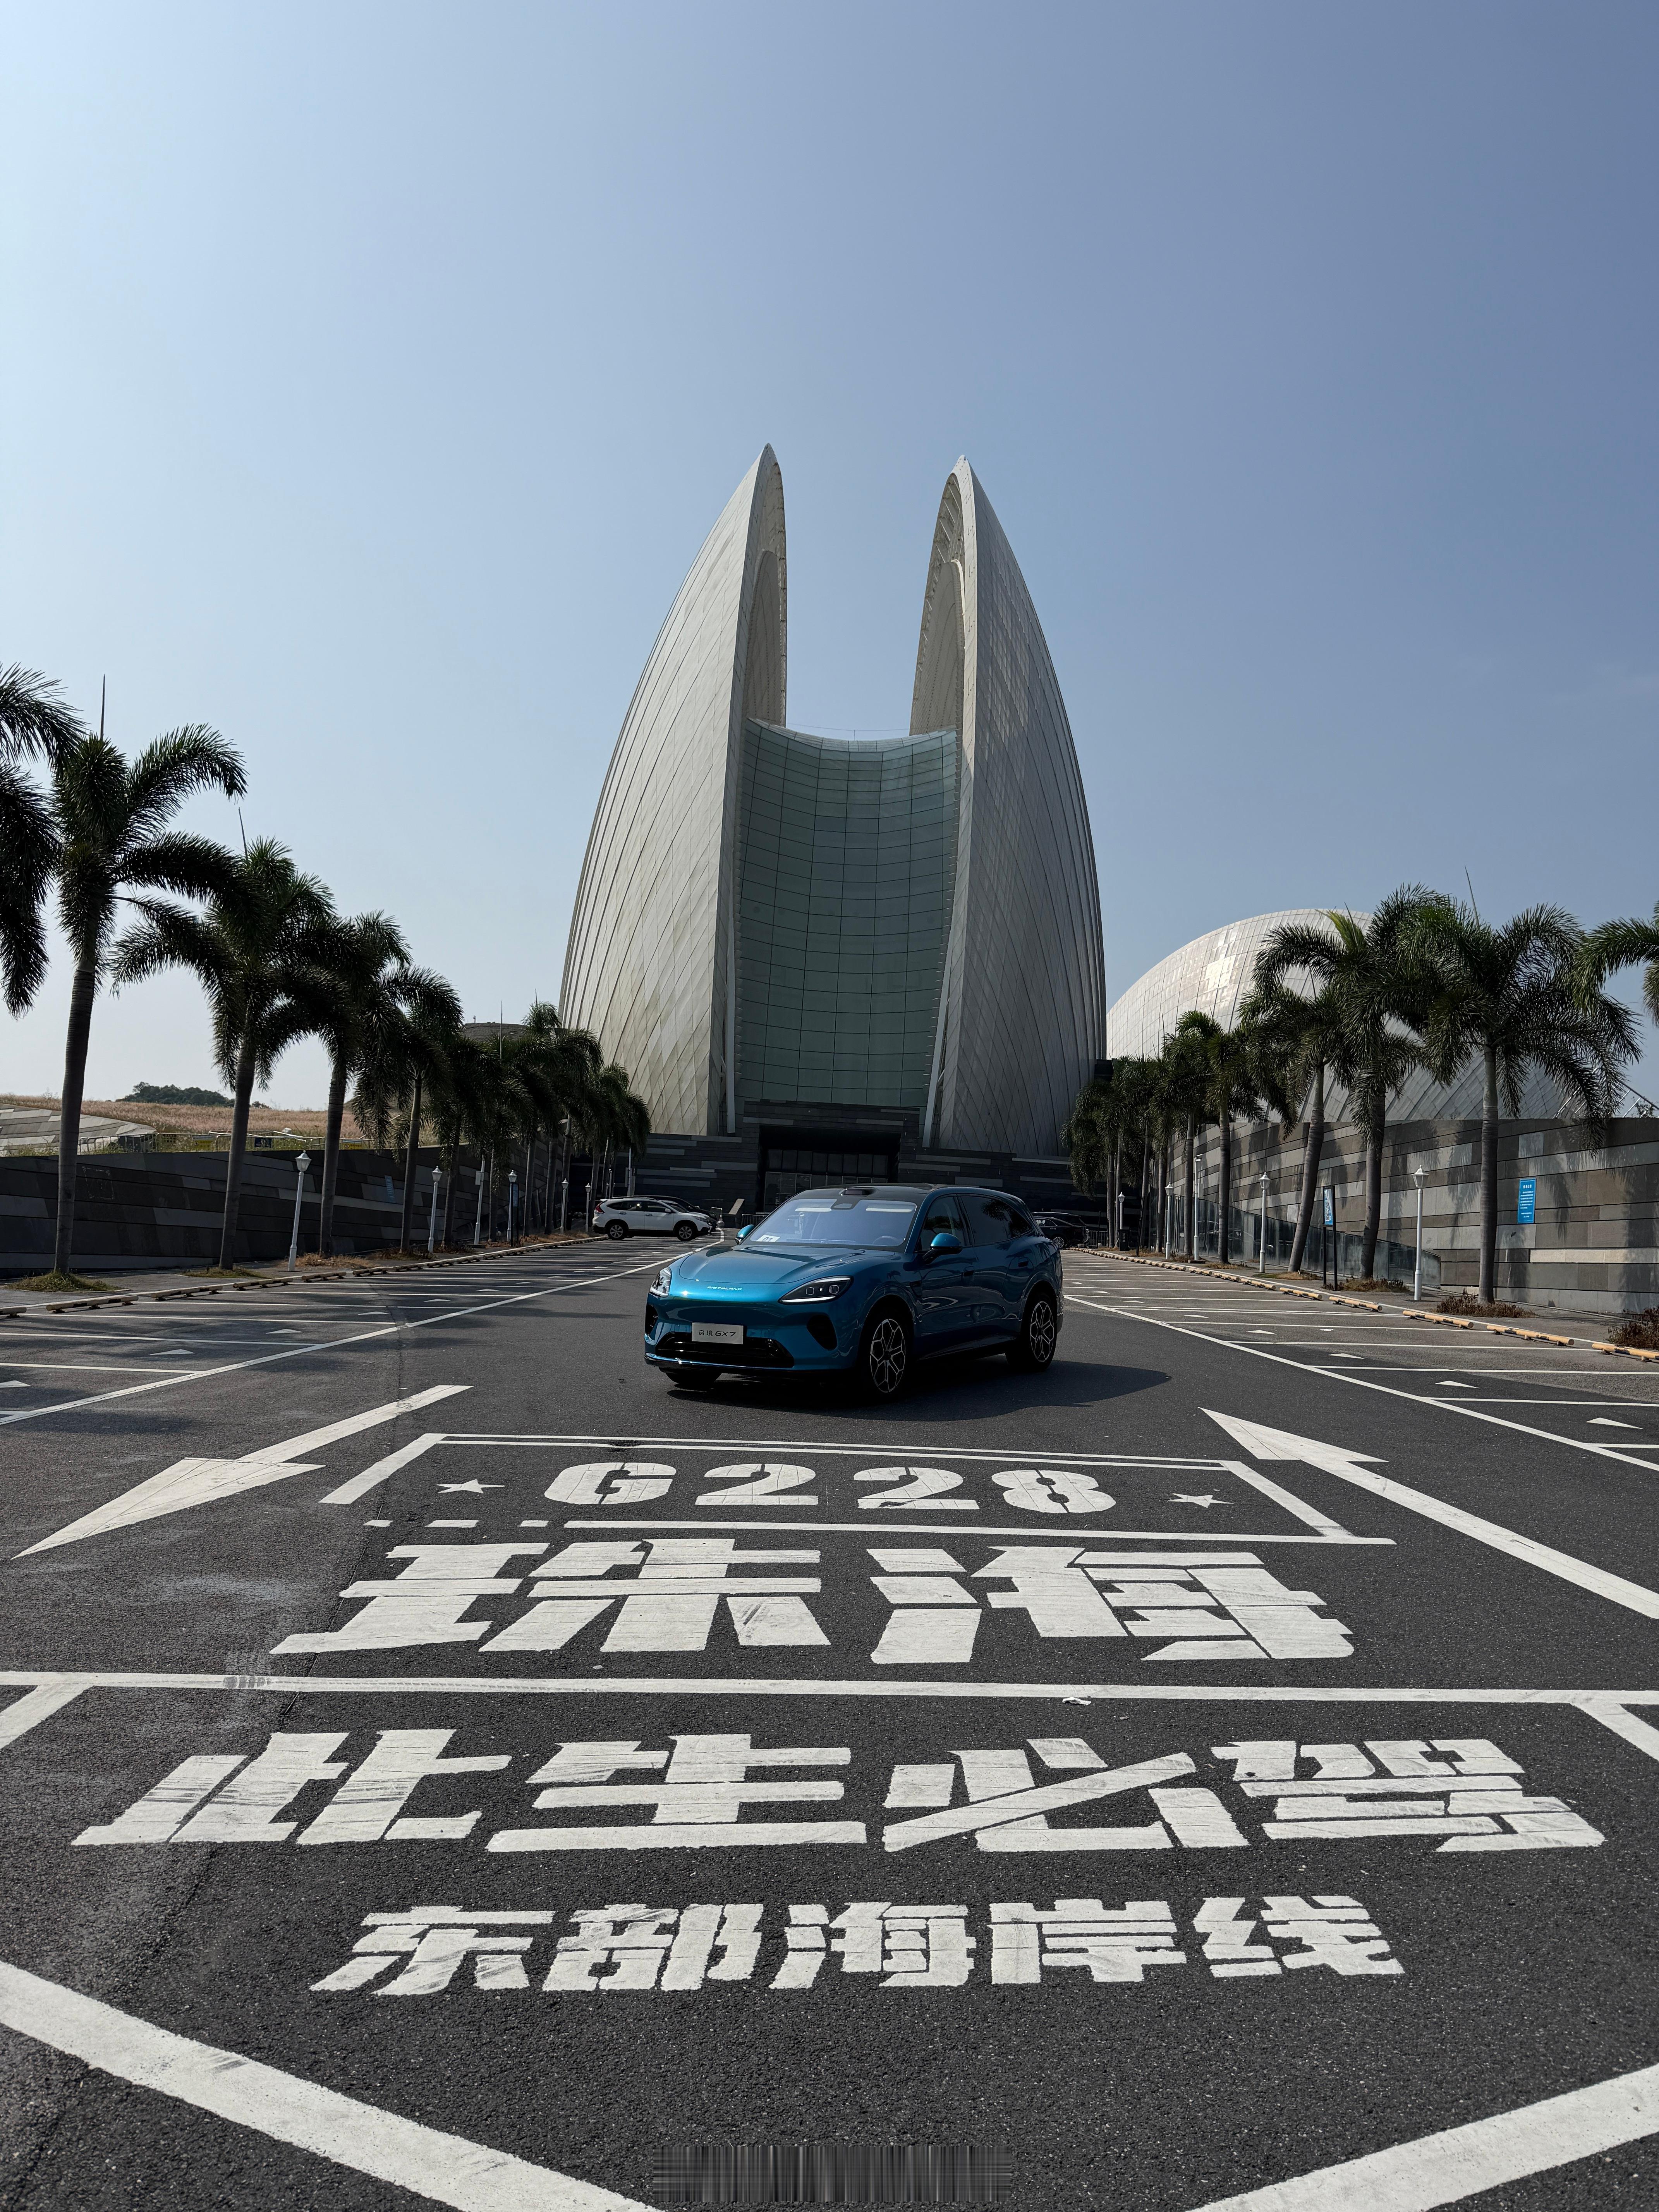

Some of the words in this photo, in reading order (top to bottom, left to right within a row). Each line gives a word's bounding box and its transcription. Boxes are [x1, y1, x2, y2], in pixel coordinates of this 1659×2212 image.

[544, 1462, 1117, 1514] G228
[268, 1537, 1355, 1665] 珠海
[70, 1728, 1609, 1853] 此生必驾
[308, 1895, 1406, 1997] 东部海岸线
